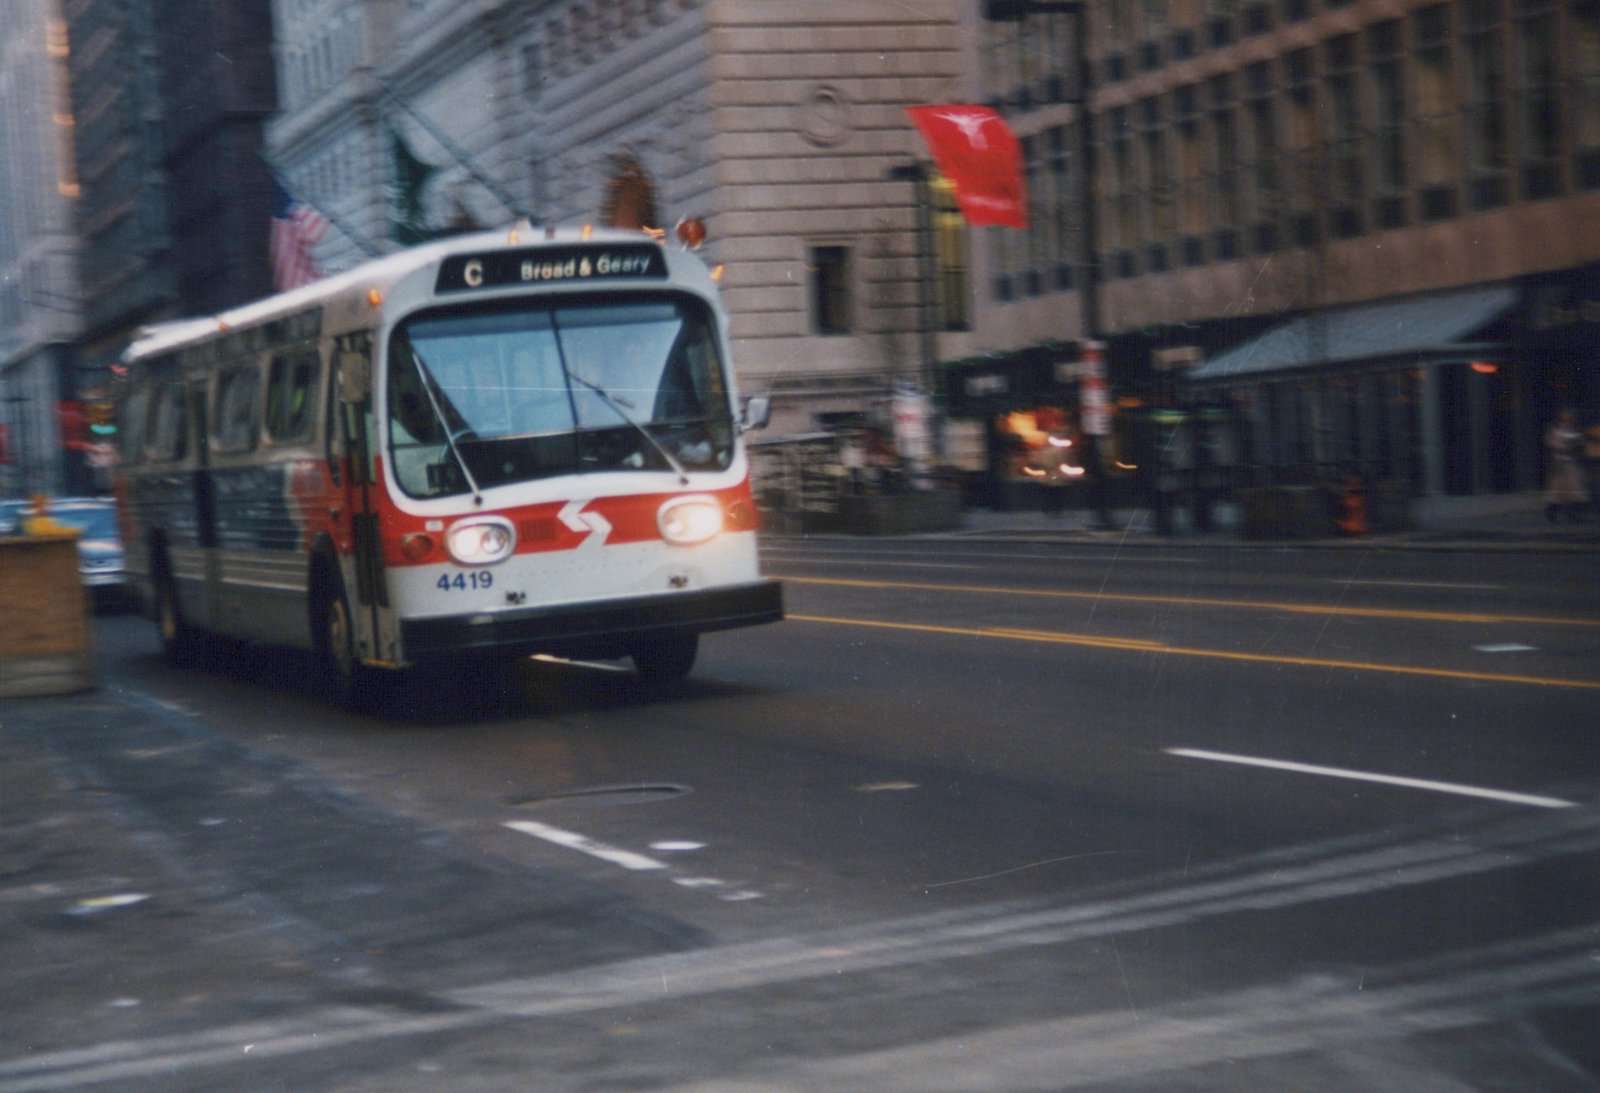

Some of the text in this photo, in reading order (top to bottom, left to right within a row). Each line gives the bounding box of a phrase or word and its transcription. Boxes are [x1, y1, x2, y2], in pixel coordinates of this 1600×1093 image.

[464, 251, 650, 287] C Broad & Geary
[436, 570, 493, 591] 4419
